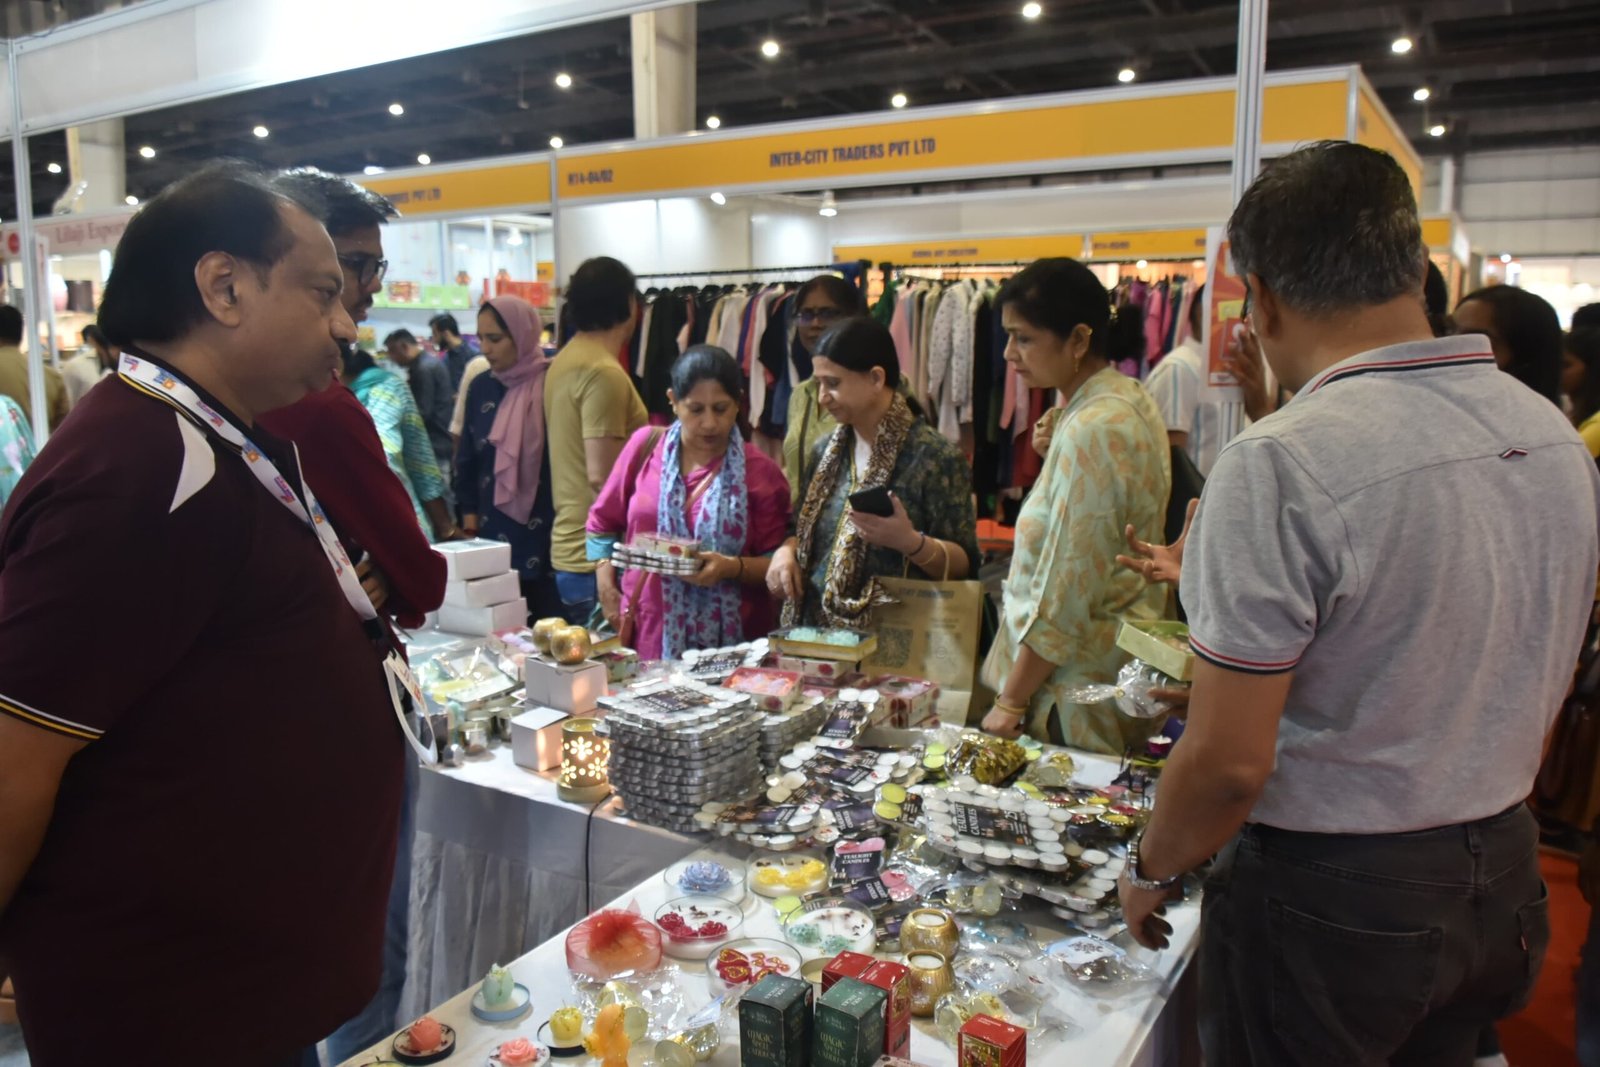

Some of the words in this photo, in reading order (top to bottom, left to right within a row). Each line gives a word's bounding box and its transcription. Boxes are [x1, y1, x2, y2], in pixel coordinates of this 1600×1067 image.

[769, 149, 828, 168] INTER-CITY
[832, 143, 885, 163] TRADERS
[889, 140, 911, 158] PVT
[914, 138, 937, 155] LTD
[955, 803, 968, 833] TEALIGHT
[967, 808, 981, 836] CANDLES
[843, 852, 873, 860] TEALIGHT
